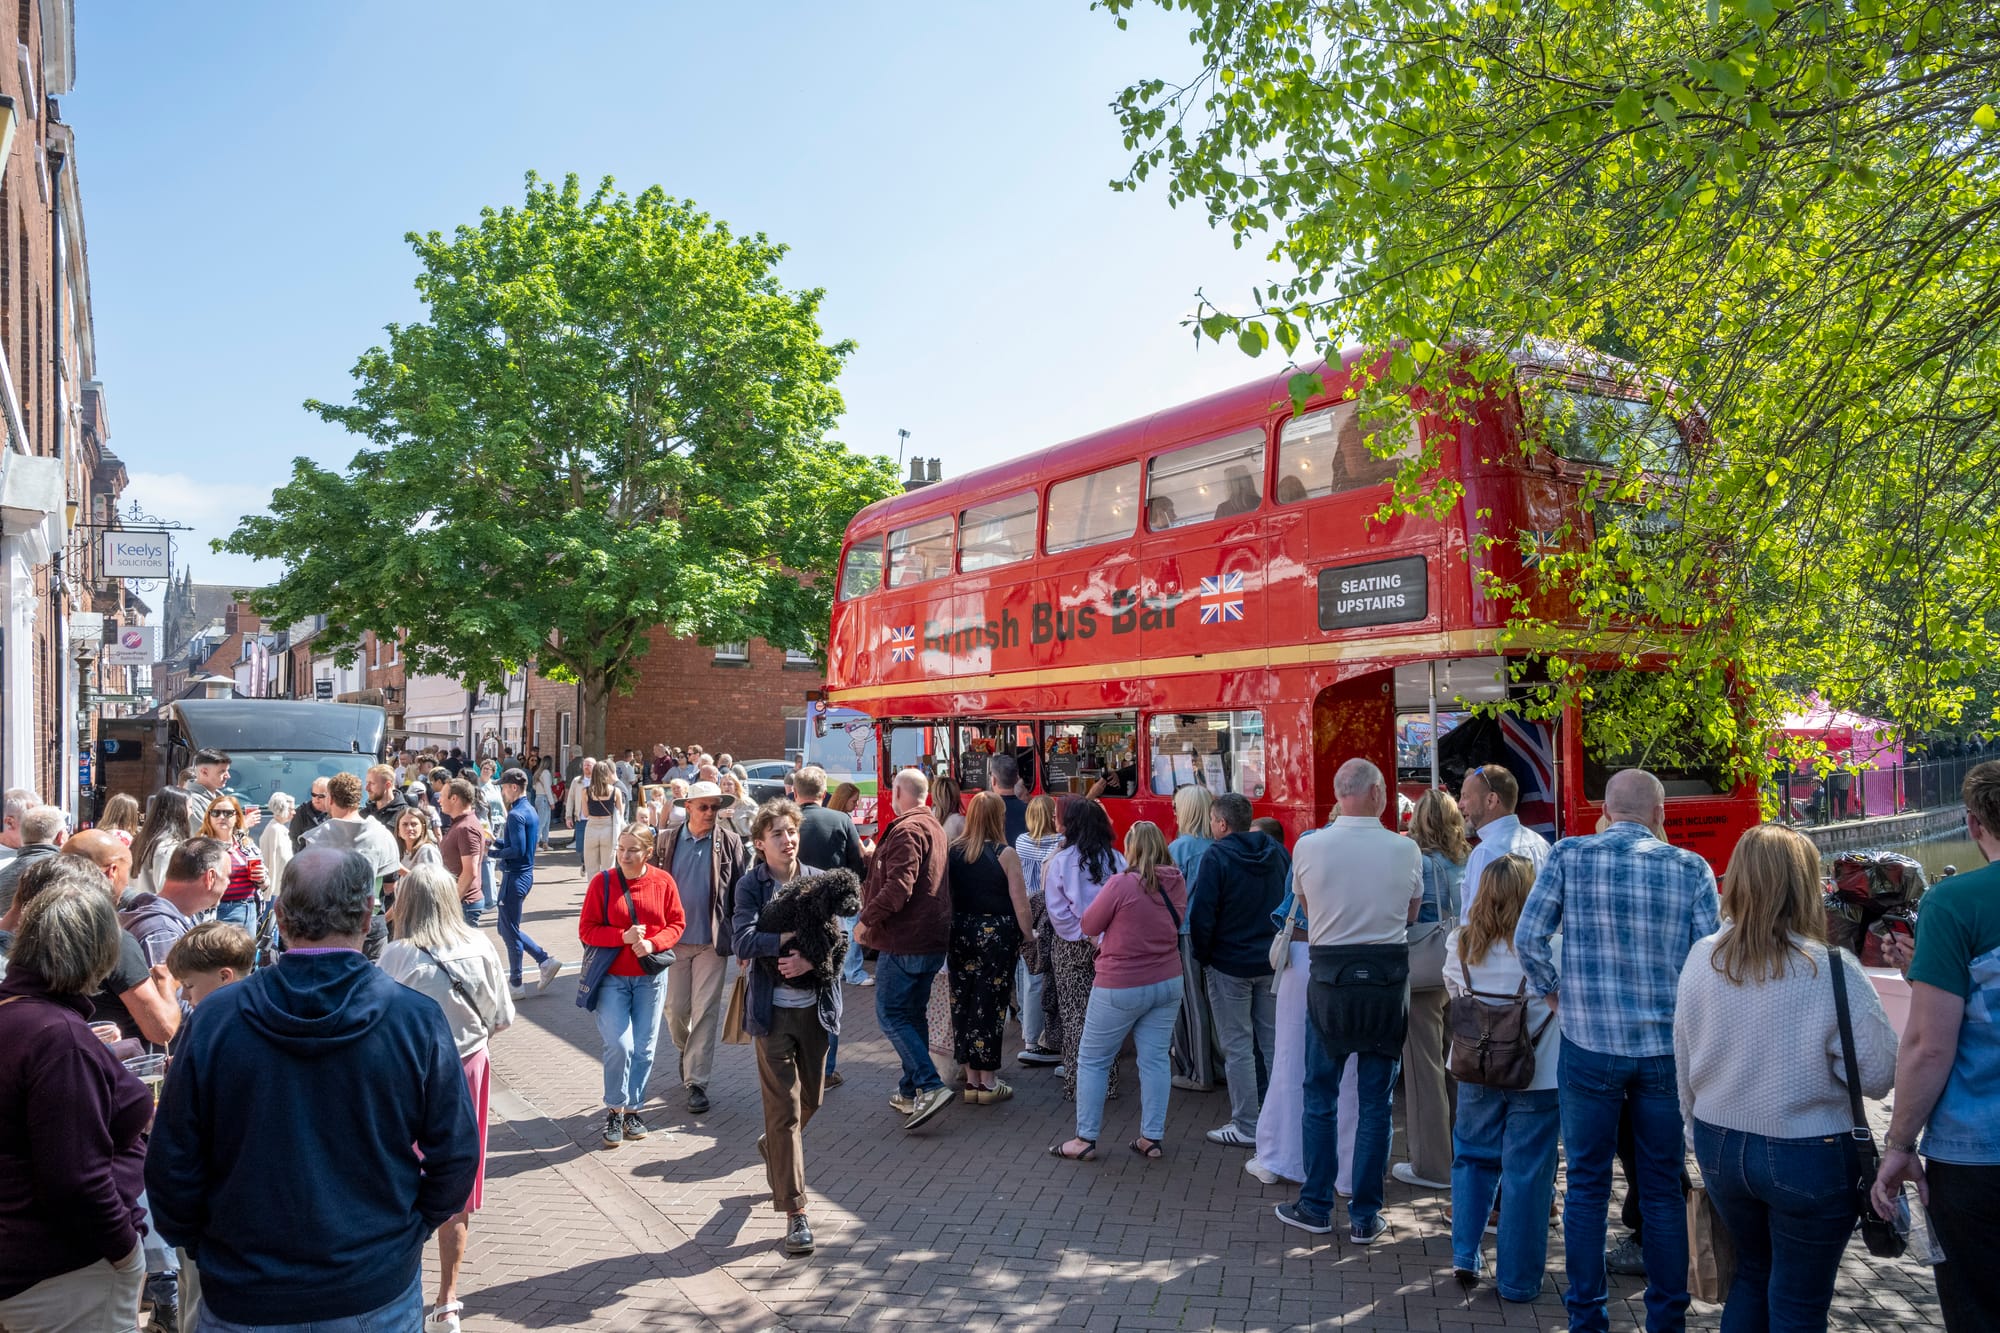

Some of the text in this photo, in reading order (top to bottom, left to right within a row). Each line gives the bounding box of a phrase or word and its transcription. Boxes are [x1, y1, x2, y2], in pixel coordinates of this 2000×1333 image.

[117, 543, 162, 559] Keelys
[117, 559, 162, 567] SOLICITORS
[1341, 574, 1401, 594] SEATING
[1337, 594, 1405, 613] UPSTAIRS
[923, 589, 1182, 654] British Bus Bar
[1686, 816, 1728, 825] INCLUDING:
